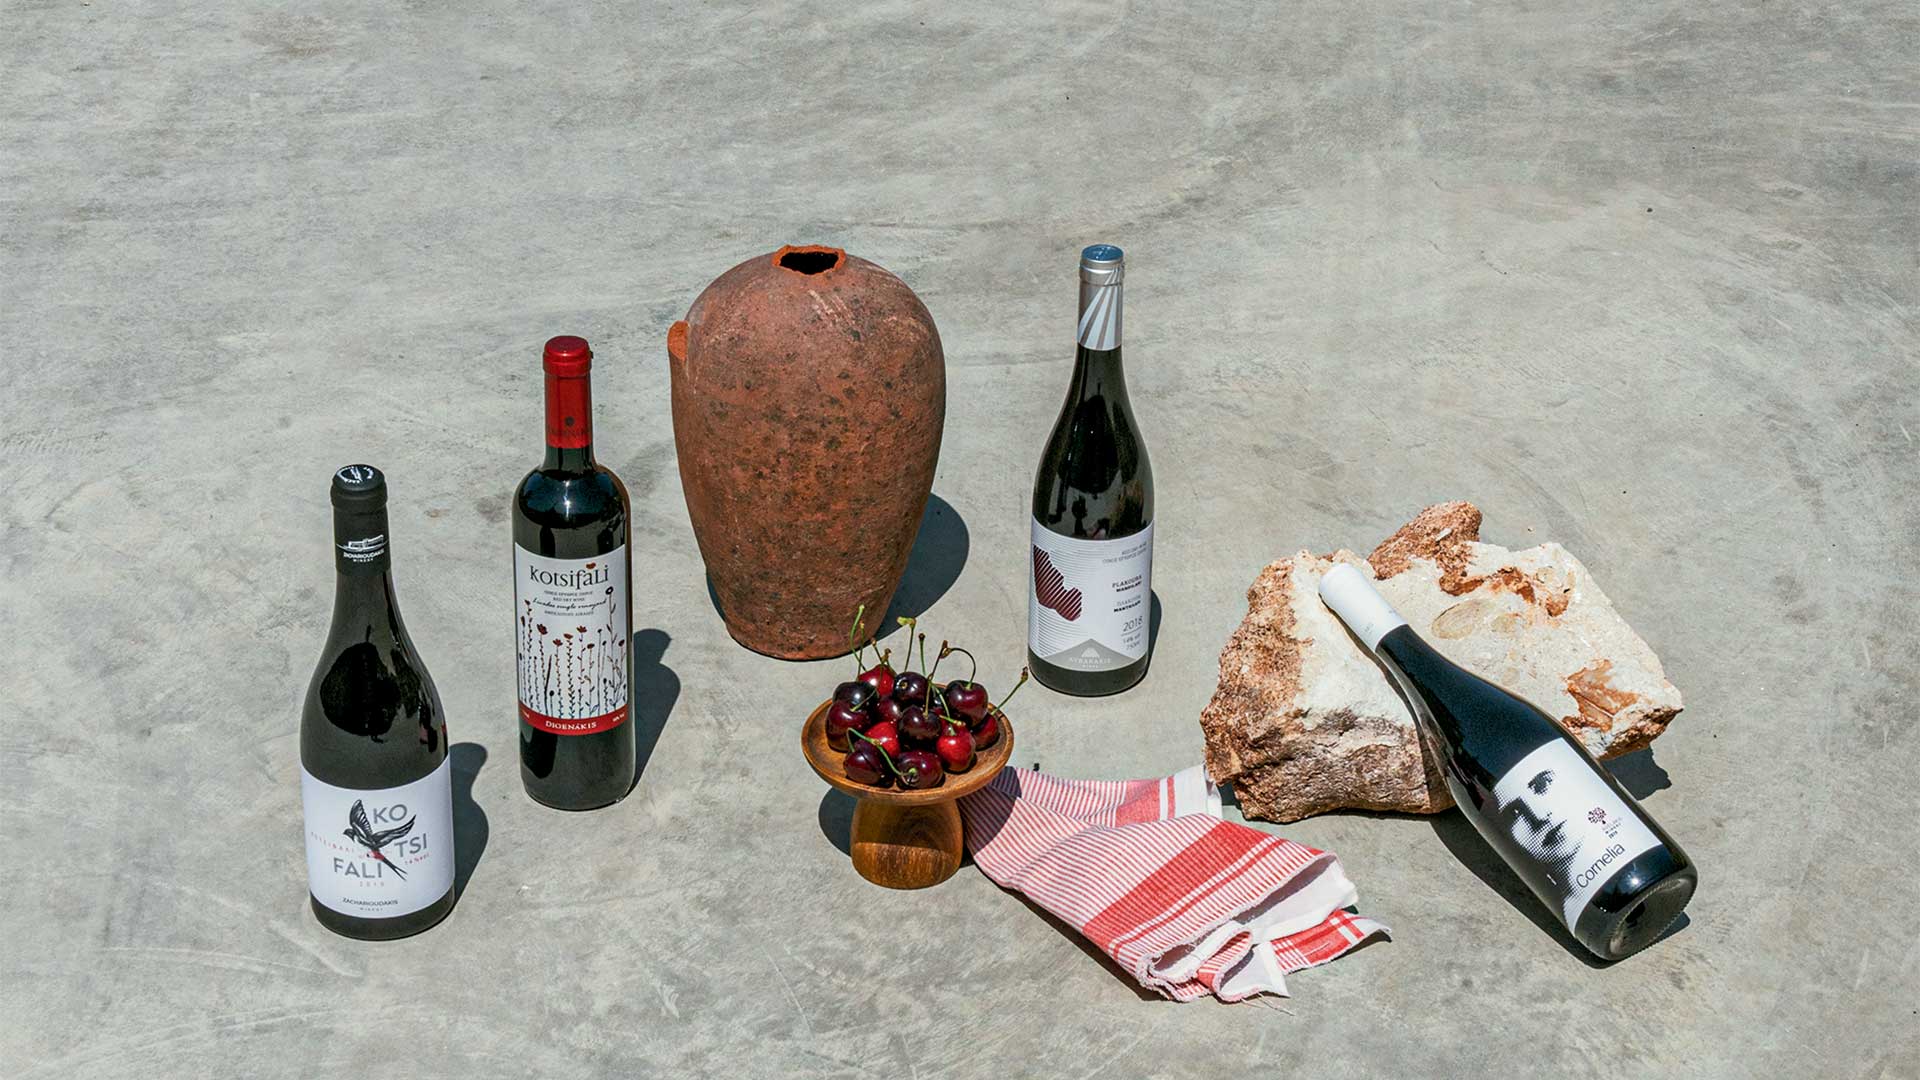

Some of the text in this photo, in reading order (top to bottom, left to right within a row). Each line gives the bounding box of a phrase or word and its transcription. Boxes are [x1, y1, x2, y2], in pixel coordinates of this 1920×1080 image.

[1122, 615, 1144, 632] 2018
[373, 804, 408, 824] KO
[394, 833, 427, 858] TSI
[333, 857, 382, 878] FALI
[1576, 843, 1625, 888] Cornelia
